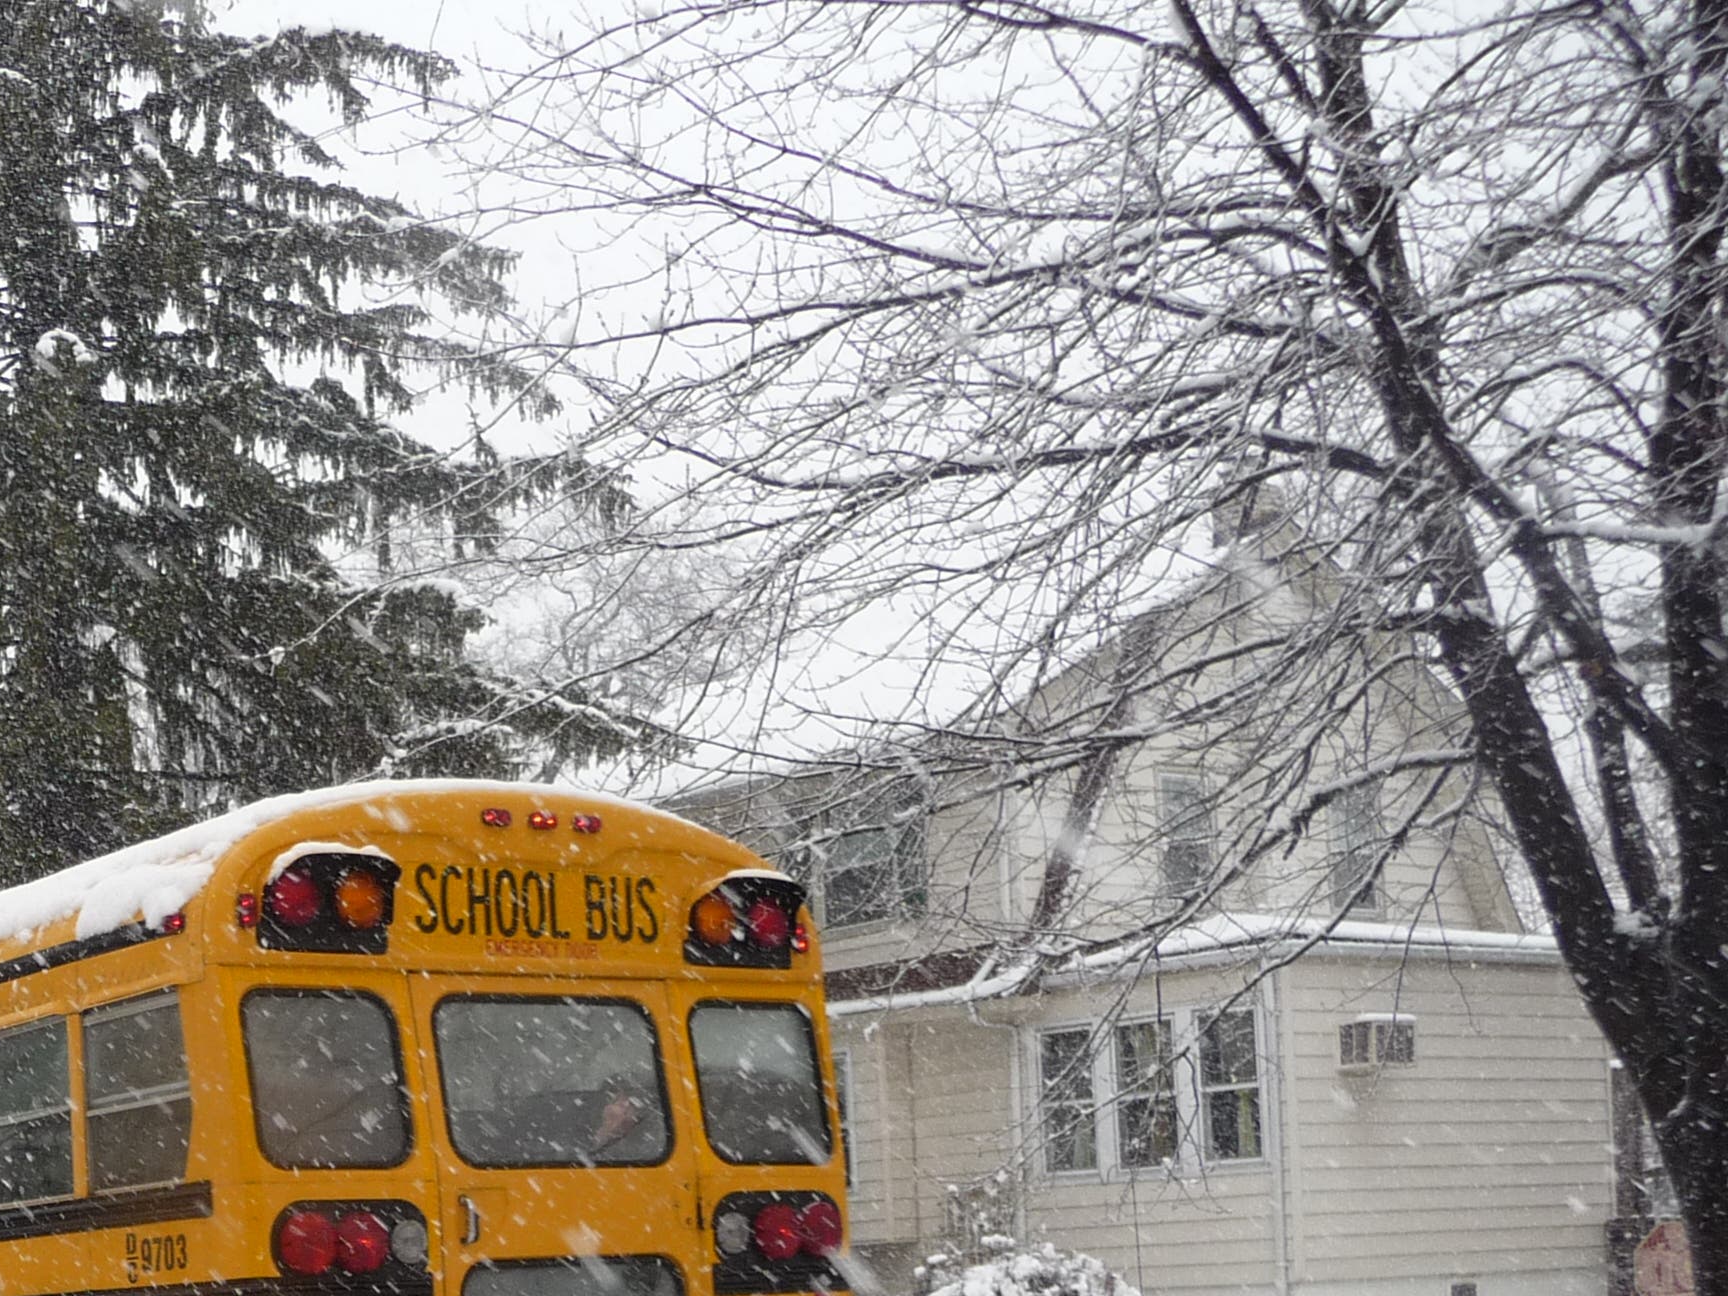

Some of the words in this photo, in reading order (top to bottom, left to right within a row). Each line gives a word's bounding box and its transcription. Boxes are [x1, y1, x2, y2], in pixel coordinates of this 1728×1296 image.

[415, 863, 570, 940] SCHOOL
[584, 874, 659, 943] BUS
[141, 1234, 188, 1272] 9703
